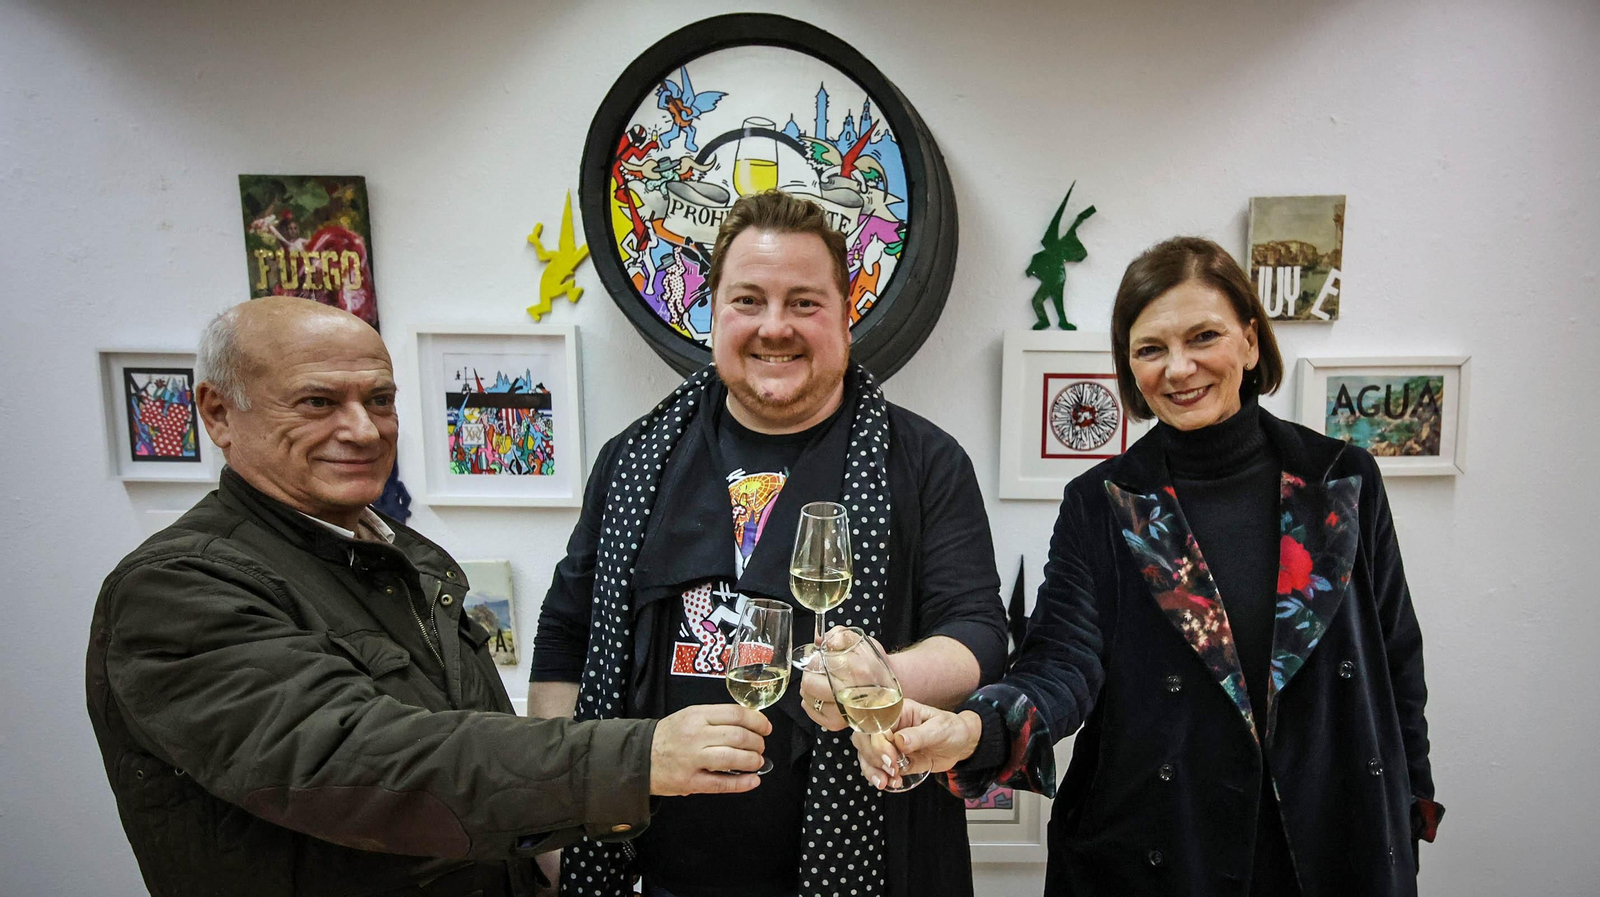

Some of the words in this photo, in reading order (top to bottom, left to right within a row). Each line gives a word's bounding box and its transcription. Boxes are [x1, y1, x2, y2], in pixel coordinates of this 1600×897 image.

[669, 198, 729, 227] PROH
[825, 209, 852, 238] TE
[254, 248, 363, 291] FUEGO
[1332, 380, 1440, 420] AGUA
